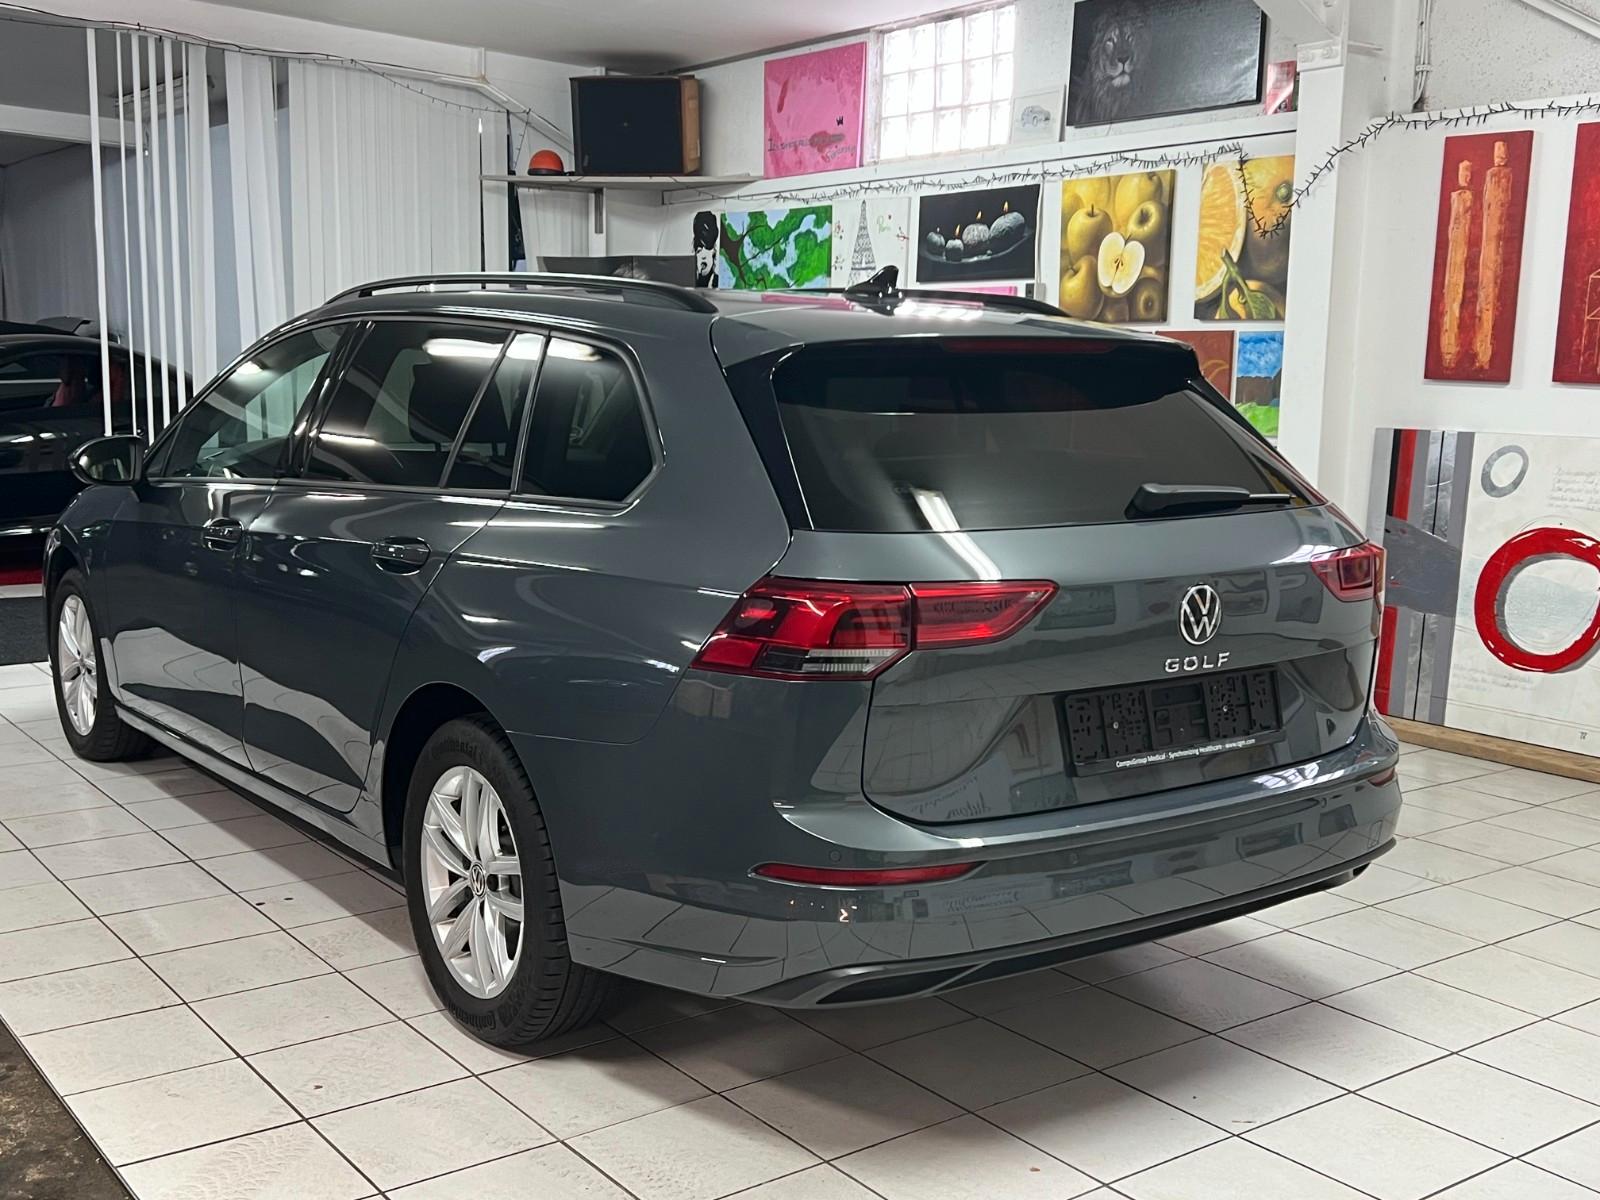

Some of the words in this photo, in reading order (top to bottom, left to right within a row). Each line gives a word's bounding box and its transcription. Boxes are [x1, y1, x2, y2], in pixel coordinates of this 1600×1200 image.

[1164, 652, 1230, 673] GOLF
[1116, 758, 1147, 768] CompuGroup
[1147, 753, 1165, 762] Medical
